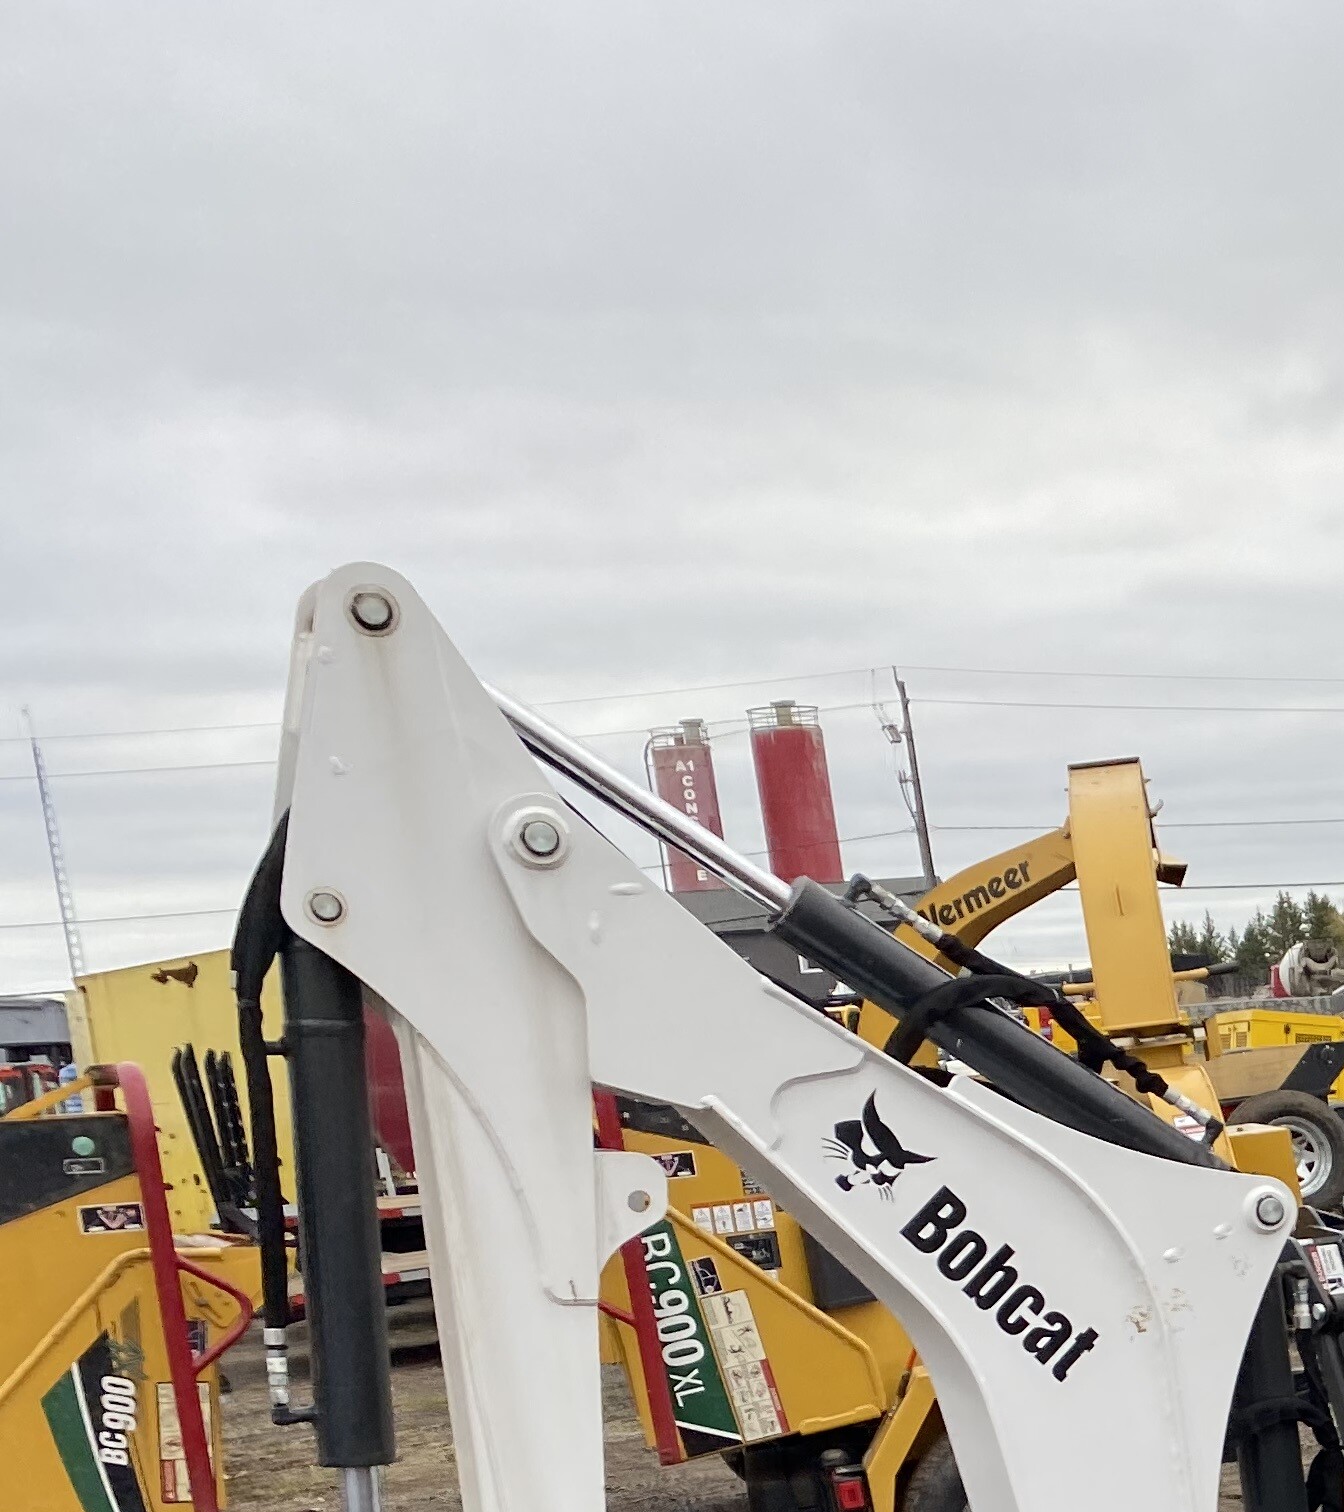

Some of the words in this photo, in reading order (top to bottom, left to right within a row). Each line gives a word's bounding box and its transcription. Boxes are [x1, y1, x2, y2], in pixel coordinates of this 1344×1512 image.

[674, 760, 695, 772] A1
[916, 860, 1031, 926] Vermeer
[899, 1184, 1100, 1383] Bobcat
[99, 1375, 137, 1467] BC900
